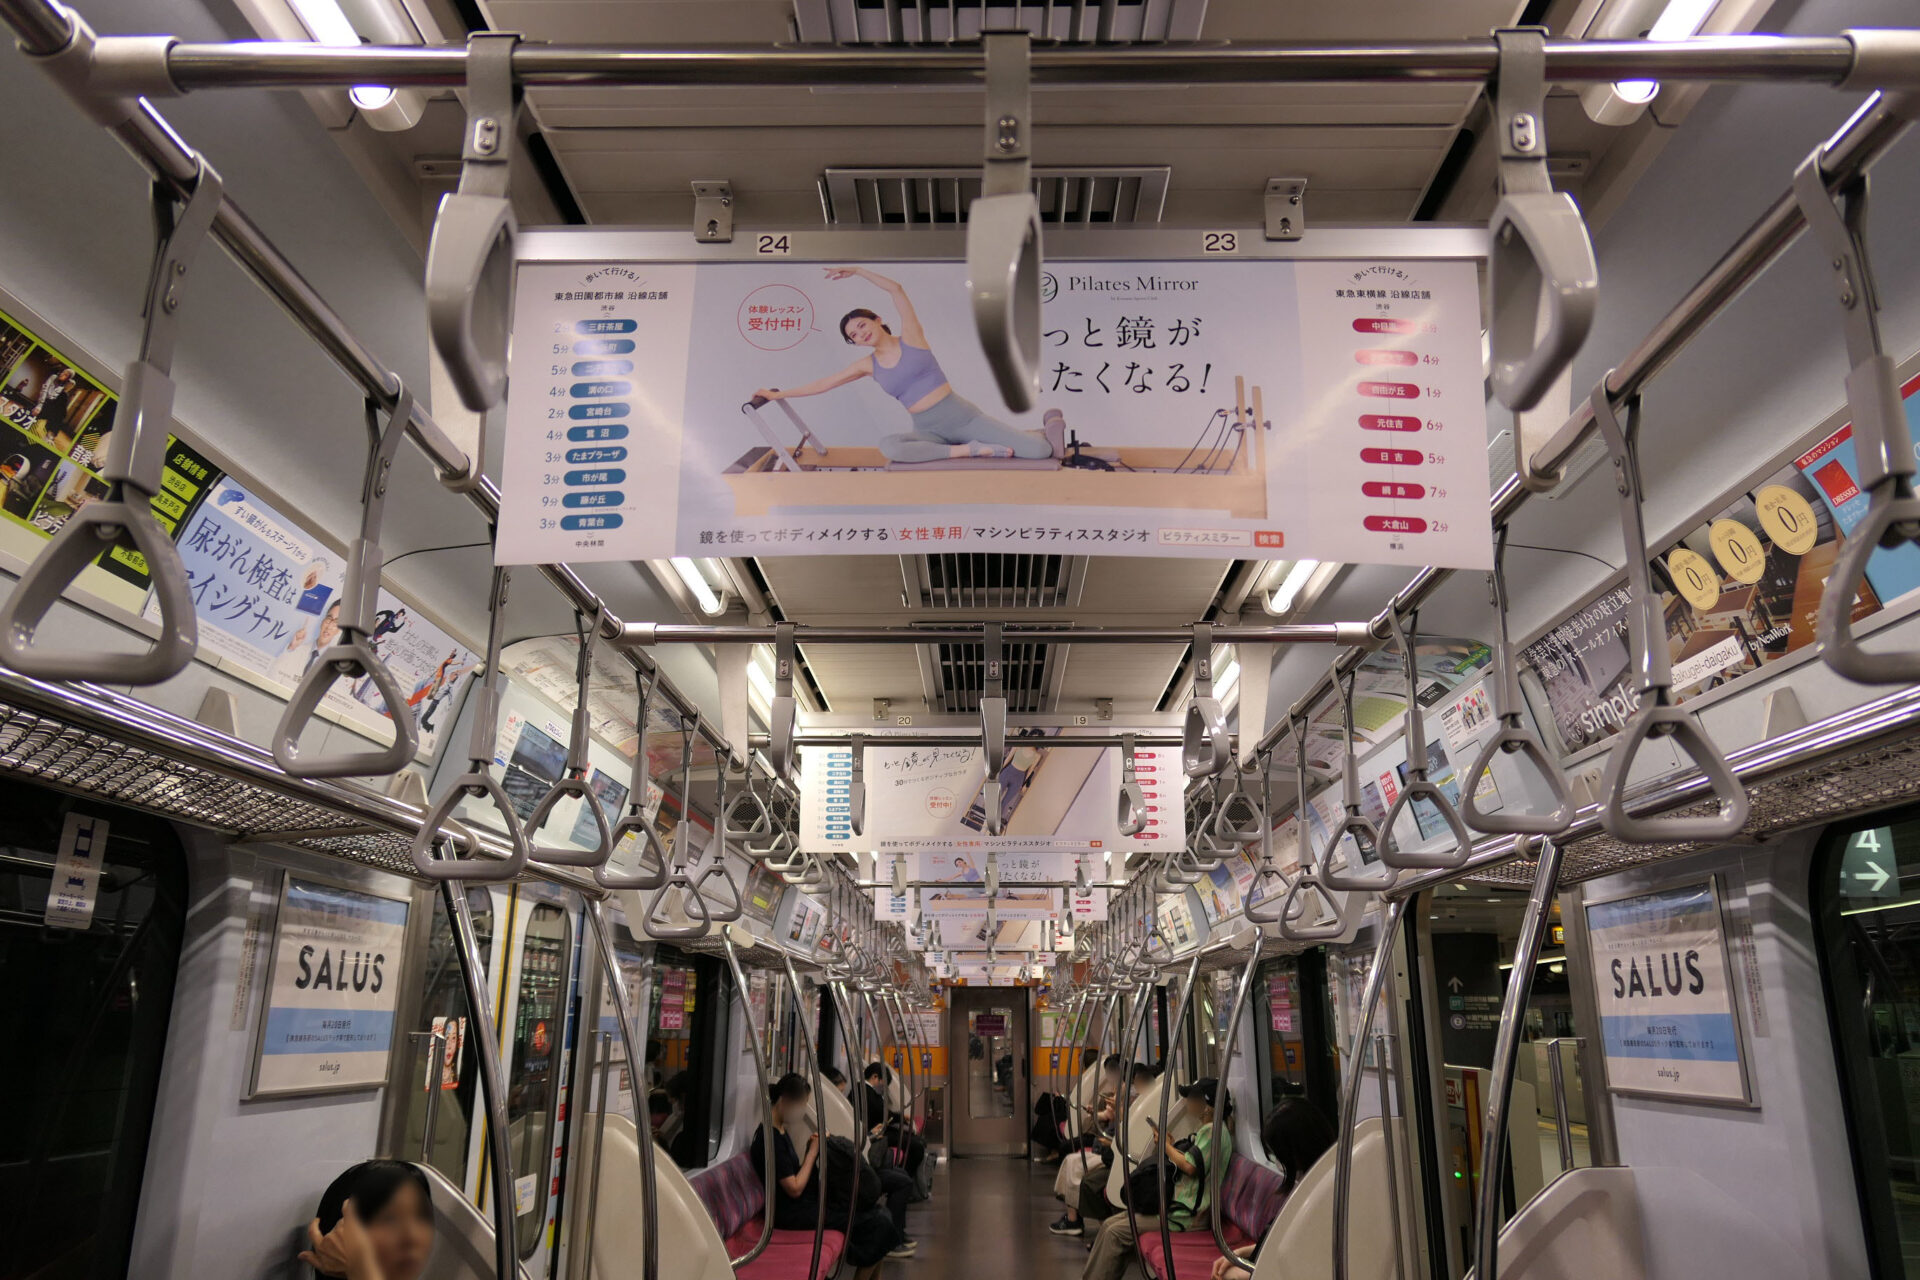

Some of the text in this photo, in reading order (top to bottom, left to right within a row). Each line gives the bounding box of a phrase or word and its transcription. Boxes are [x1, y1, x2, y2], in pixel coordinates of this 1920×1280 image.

[759, 235, 790, 254] 24
[1205, 233, 1236, 251] 23
[1069, 276, 1199, 291] Pilates Mirror
[554, 291, 668, 301] 東急田園都市線 沿線店舗
[1335, 289, 1431, 300] 東急東横線 沿線店舗
[748, 305, 805, 314] 体験レッスン
[748, 317, 802, 331] 受付中!
[552, 343, 569, 354] 5分
[1422, 354, 1440, 366] 4分
[551, 365, 567, 376] 5分
[1040, 361, 1212, 393] たくなる!
[549, 387, 567, 398] 4分
[1425, 386, 1442, 399] 1分
[548, 408, 565, 419] 2分
[1426, 420, 1444, 431] 6分
[546, 430, 563, 441] 4分
[545, 452, 562, 463] 3分
[571, 449, 621, 461] たまプラーザ
[1428, 453, 1445, 464] 5分
[172, 453, 209, 481] 店舗情報
[543, 474, 560, 485] 3分
[1430, 486, 1448, 498] 7分
[1833, 486, 1859, 506] DRESSER
[541, 496, 559, 507] 9分
[539, 518, 557, 530] 3分
[1431, 520, 1449, 533] 2分
[700, 528, 889, 544] 鏡を使ってボディメイクする
[898, 526, 963, 541] 女性専用
[972, 527, 1151, 542] マシンピラティススタジオ
[1257, 533, 1282, 546] 検索
[186, 516, 298, 605] 尿がん検査は
[898, 717, 911, 725] 20
[1075, 717, 1087, 725] 19
[1855, 829, 1881, 853] 4
[295, 944, 386, 994] SALUS
[1611, 949, 1704, 999] SALUS
[1657, 1066, 1680, 1083] salus.jp
